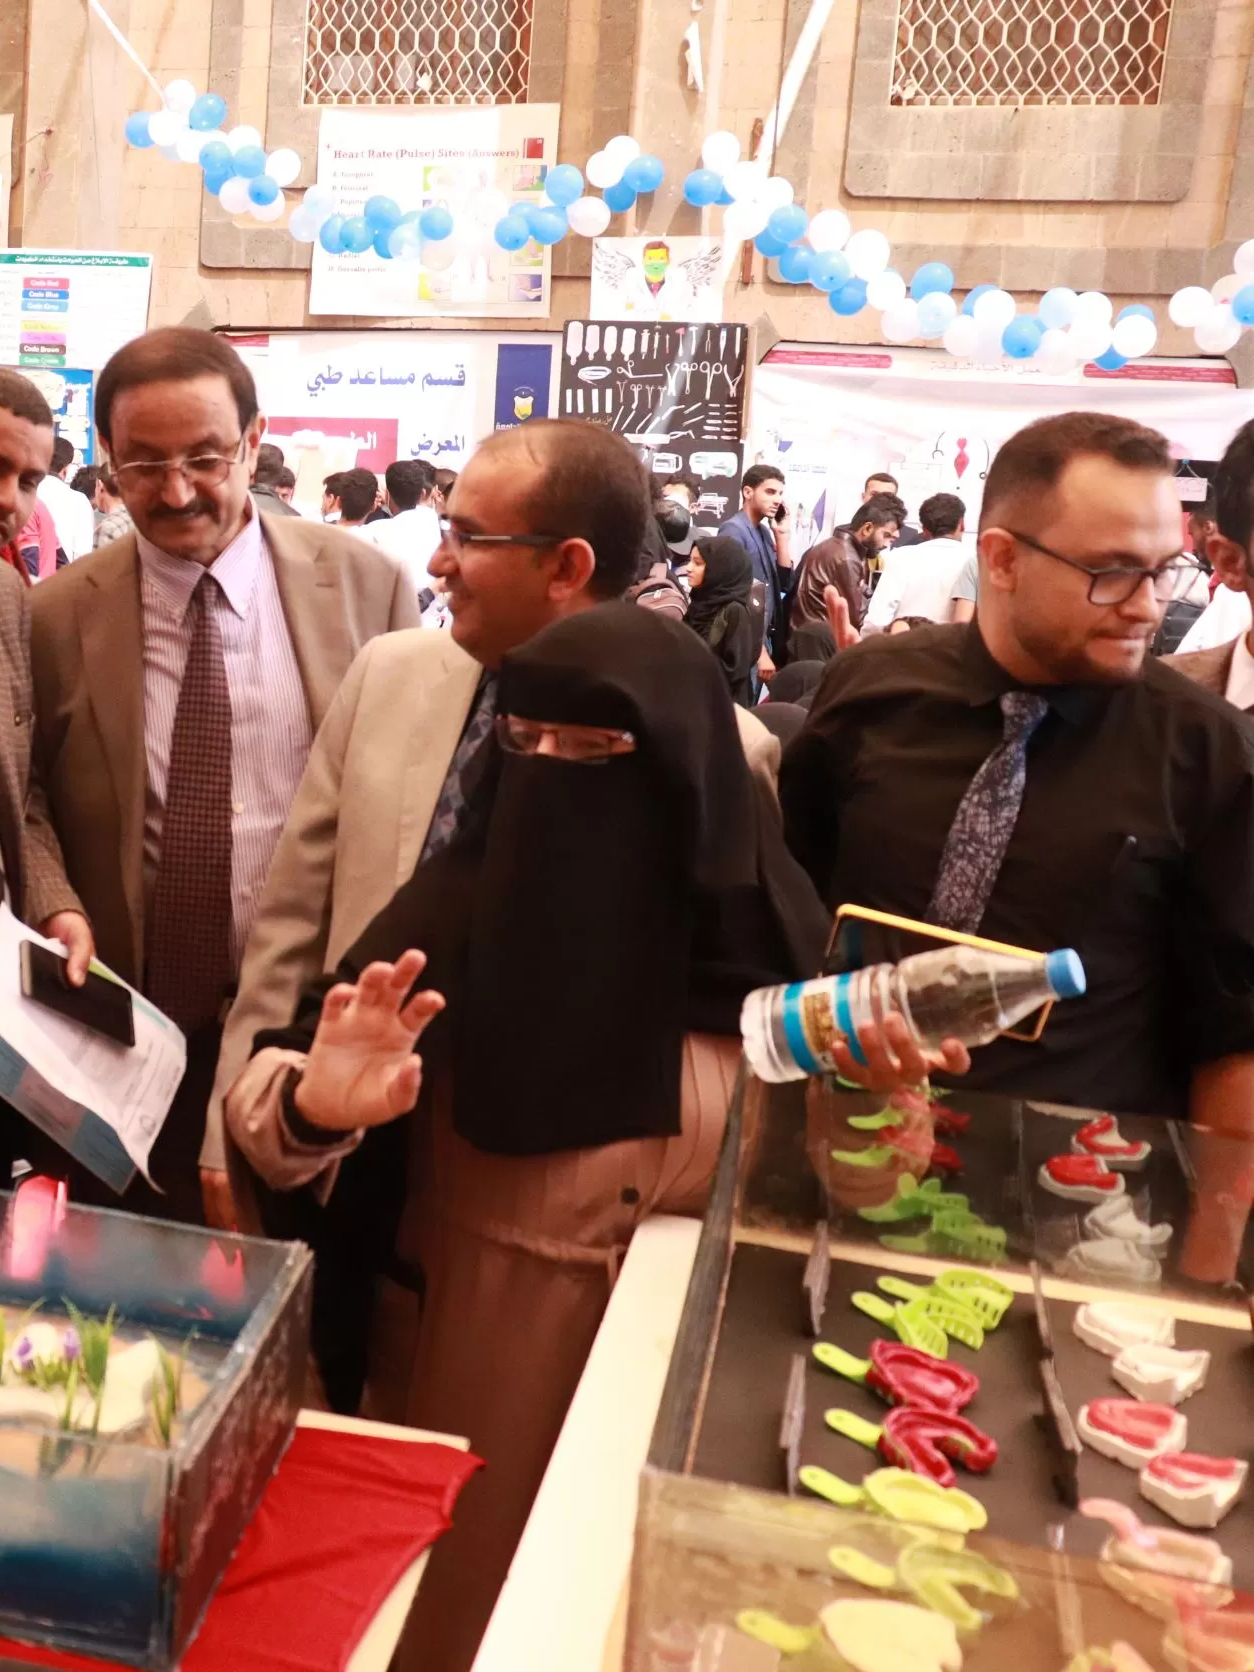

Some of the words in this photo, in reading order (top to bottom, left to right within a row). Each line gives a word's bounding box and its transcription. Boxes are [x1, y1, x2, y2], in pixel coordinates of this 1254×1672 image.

[333, 149, 365, 160] Heart
[367, 148, 393, 160] Rate
[395, 148, 436, 161] (Pulse)
[437, 147, 465, 159] Sites
[467, 147, 520, 159] (Answers)
[306, 363, 344, 397] طبي
[349, 366, 416, 386] مساعد
[421, 363, 466, 392] قسم
[410, 433, 466, 457] المعرض
